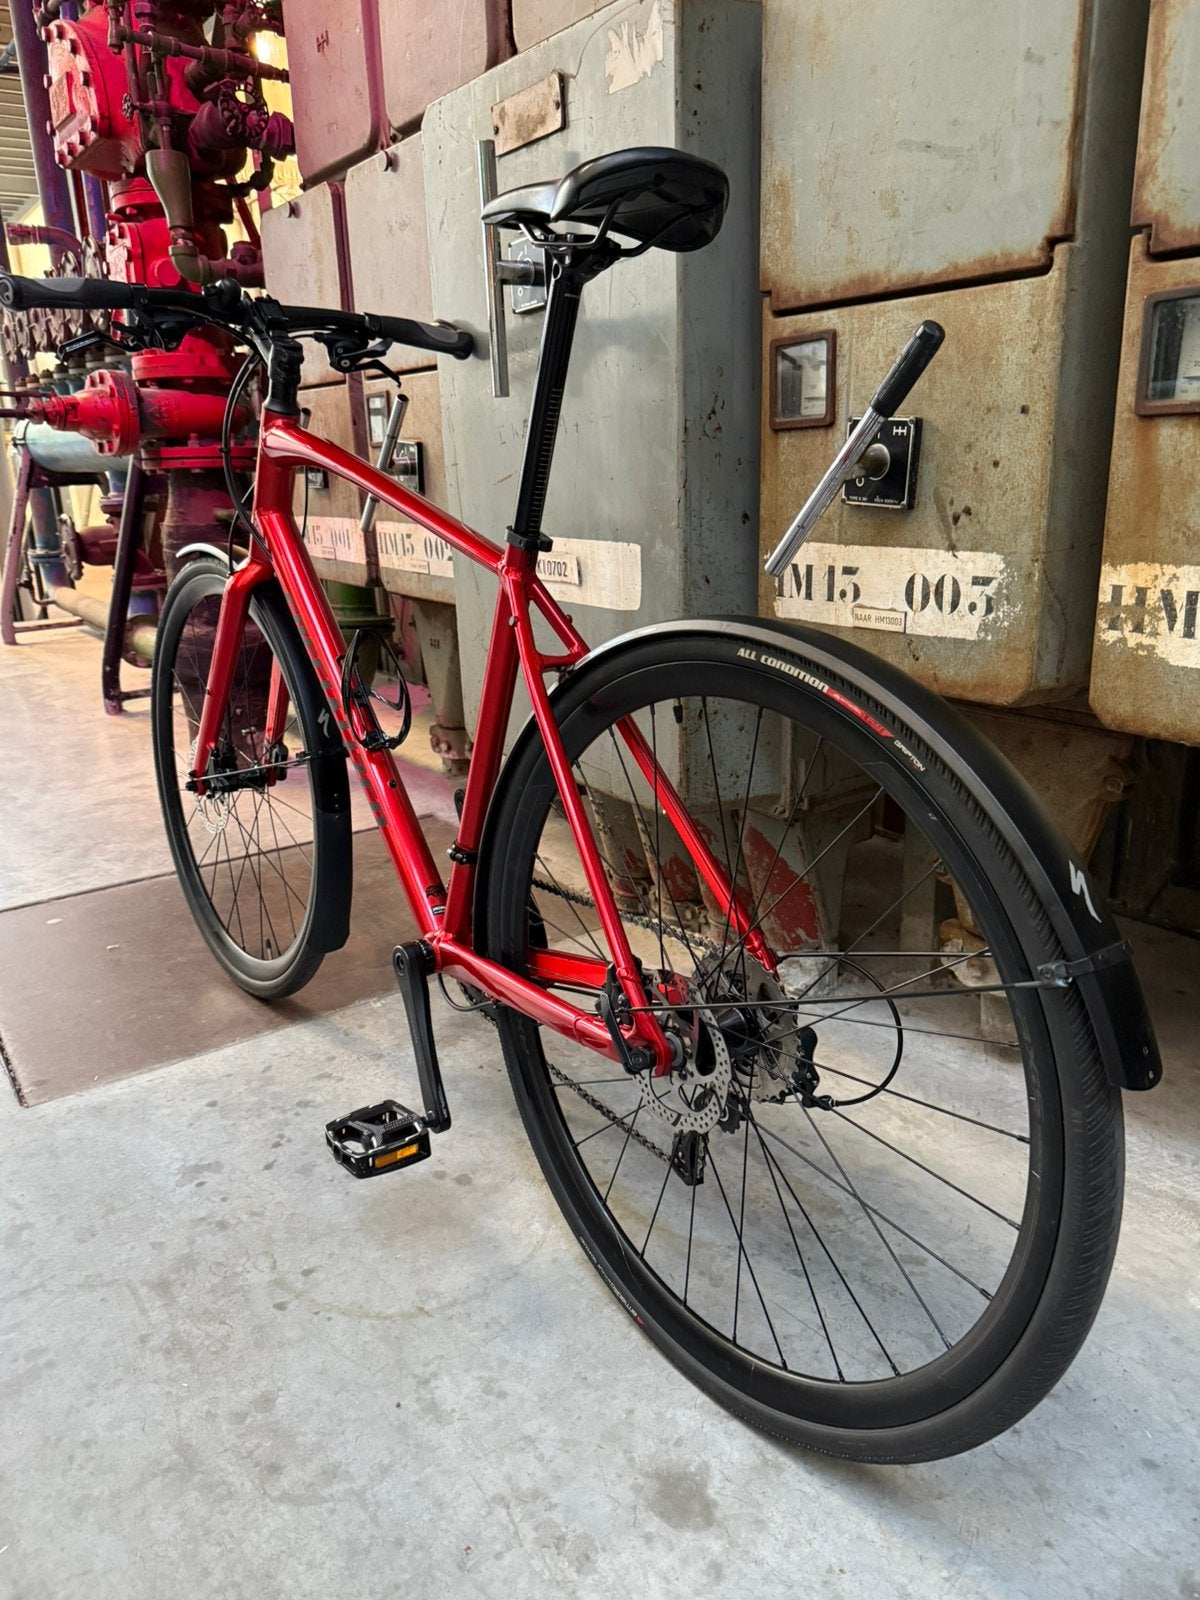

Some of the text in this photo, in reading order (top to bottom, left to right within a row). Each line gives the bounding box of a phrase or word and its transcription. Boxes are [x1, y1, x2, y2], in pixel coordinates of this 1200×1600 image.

[904, 572, 996, 618] 003
[854, 614, 903, 627] NAAR HM13003
[736, 647, 757, 662] ALL
[893, 739, 926, 772] GRIPTON
